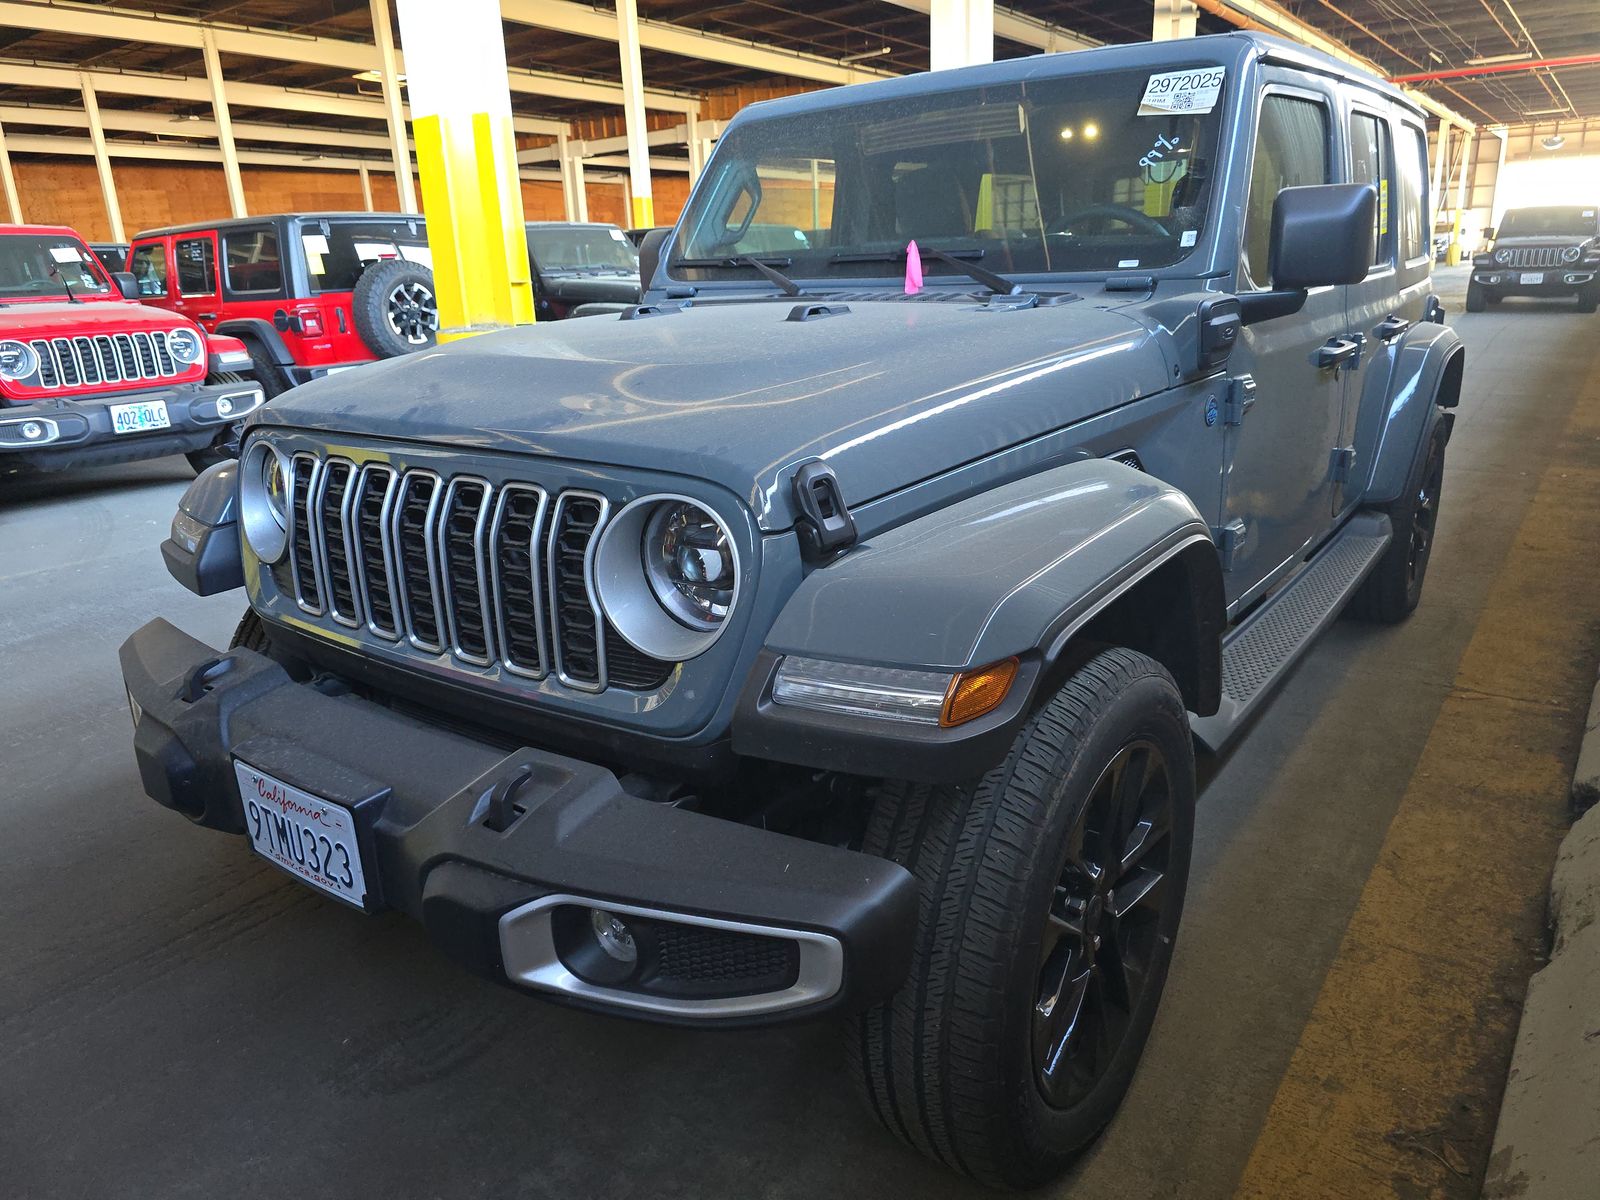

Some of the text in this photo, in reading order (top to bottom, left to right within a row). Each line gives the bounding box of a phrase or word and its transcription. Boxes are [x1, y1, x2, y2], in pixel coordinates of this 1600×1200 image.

[1149, 72, 1223, 93] 2972025
[117, 411, 138, 427] 402
[257, 778, 331, 828] California
[249, 800, 353, 889] 9TMU323
[275, 853, 335, 887] dmv.ca.gov
